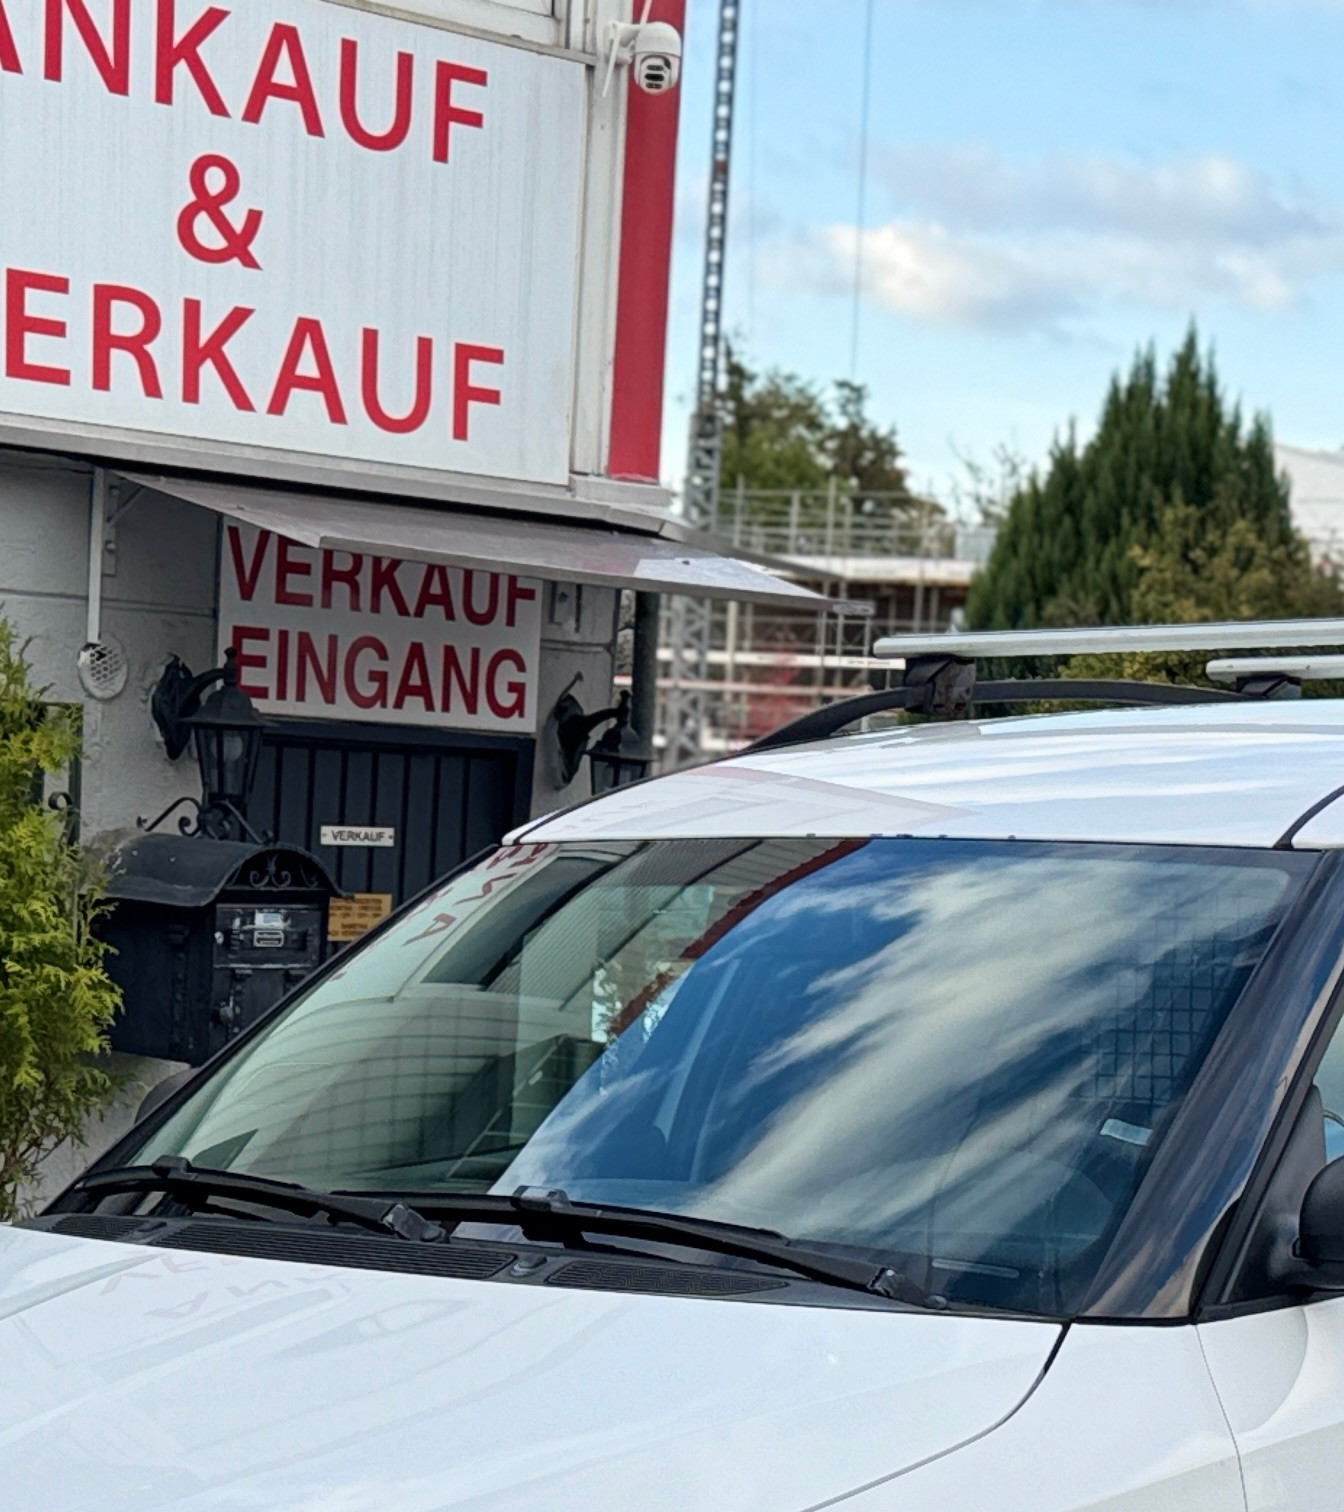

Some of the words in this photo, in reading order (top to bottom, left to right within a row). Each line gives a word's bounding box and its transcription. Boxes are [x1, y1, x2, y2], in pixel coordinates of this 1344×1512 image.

[177, 154, 262, 270] &
[227, 526, 537, 628] VERKAUF
[232, 625, 526, 719] EINGANG
[331, 830, 385, 842] VERKAUF
